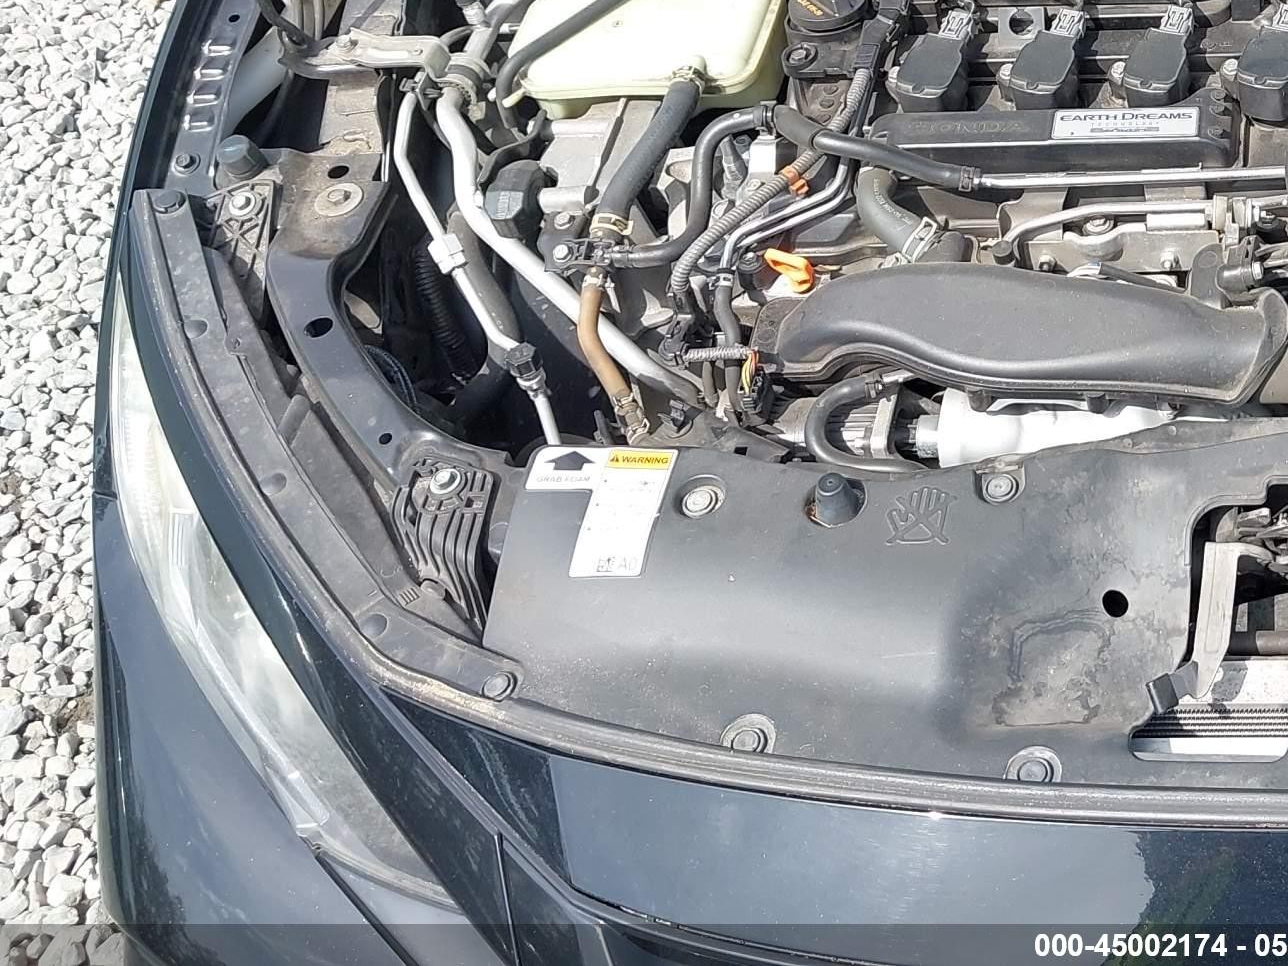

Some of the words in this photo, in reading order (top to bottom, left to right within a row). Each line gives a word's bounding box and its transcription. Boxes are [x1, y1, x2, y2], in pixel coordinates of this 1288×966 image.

[1060, 113, 1117, 121] EARTH
[1121, 112, 1192, 120] DREAMS
[621, 456, 669, 464] WARNING
